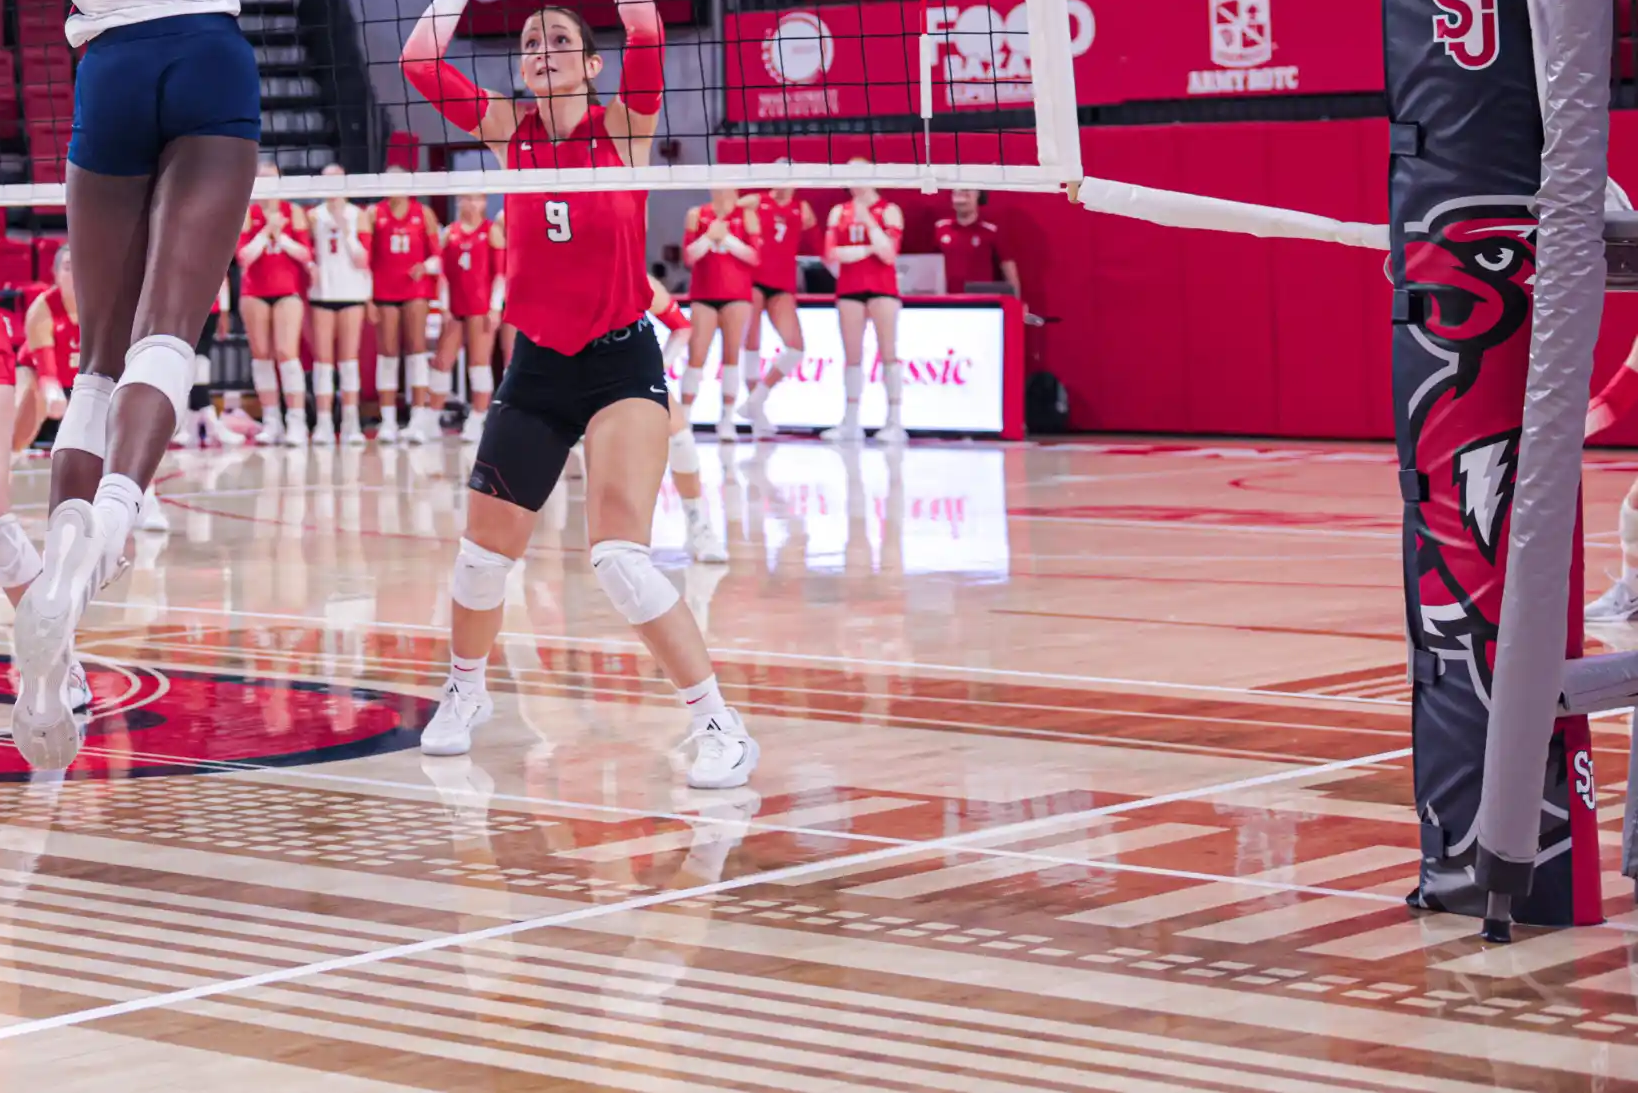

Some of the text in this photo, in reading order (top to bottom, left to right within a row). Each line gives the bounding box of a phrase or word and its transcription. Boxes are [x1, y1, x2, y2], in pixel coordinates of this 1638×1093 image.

[1187, 65, 1299, 95] ARMY ROTC
[545, 200, 573, 243] 9
